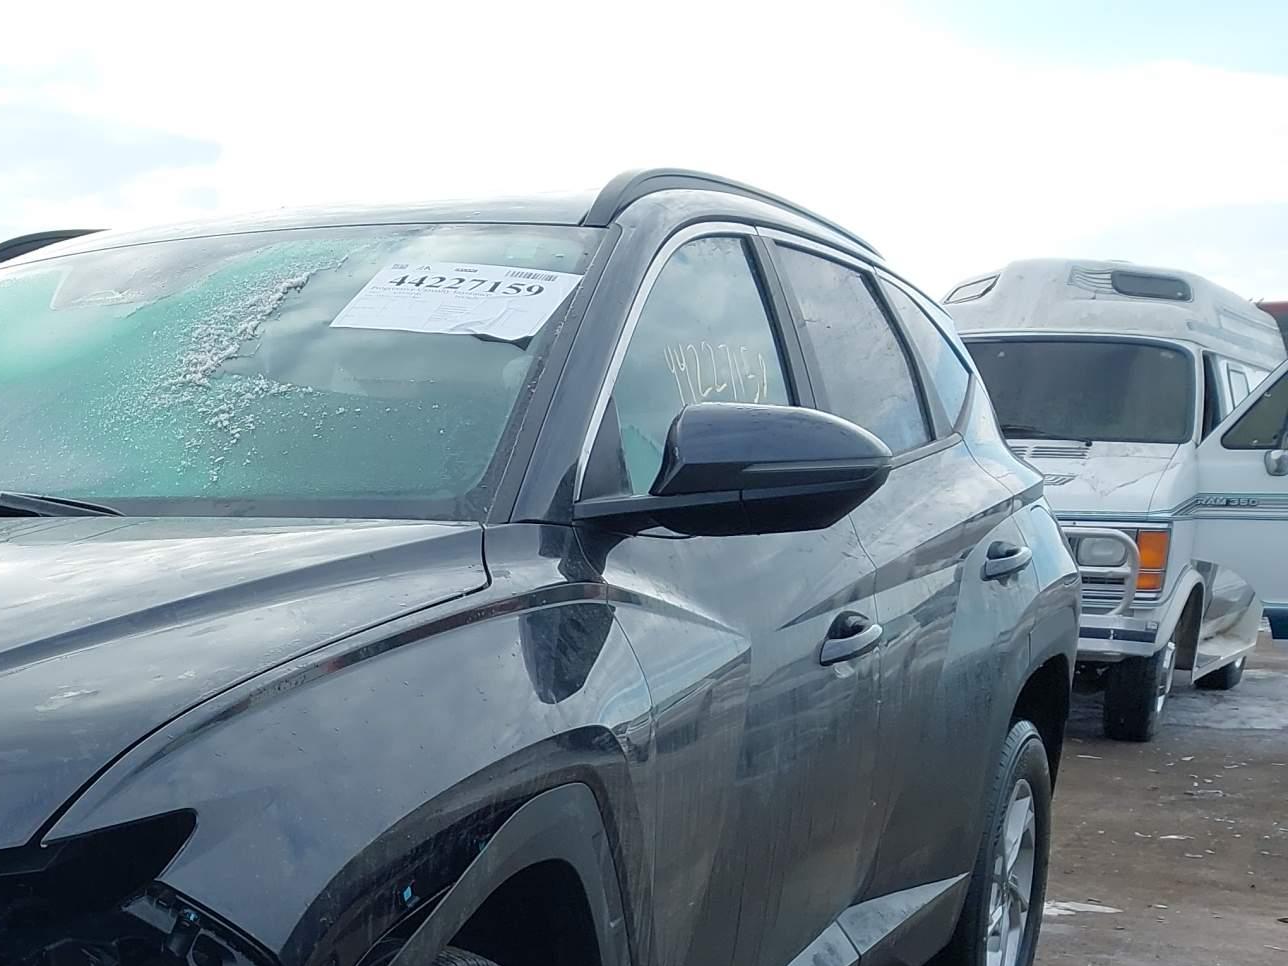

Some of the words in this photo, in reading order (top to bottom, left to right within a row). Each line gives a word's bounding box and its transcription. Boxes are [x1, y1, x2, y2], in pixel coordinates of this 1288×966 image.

[388, 273, 546, 297] 44227159
[1194, 496, 1227, 506] RAM
[1229, 498, 1258, 506] 350
